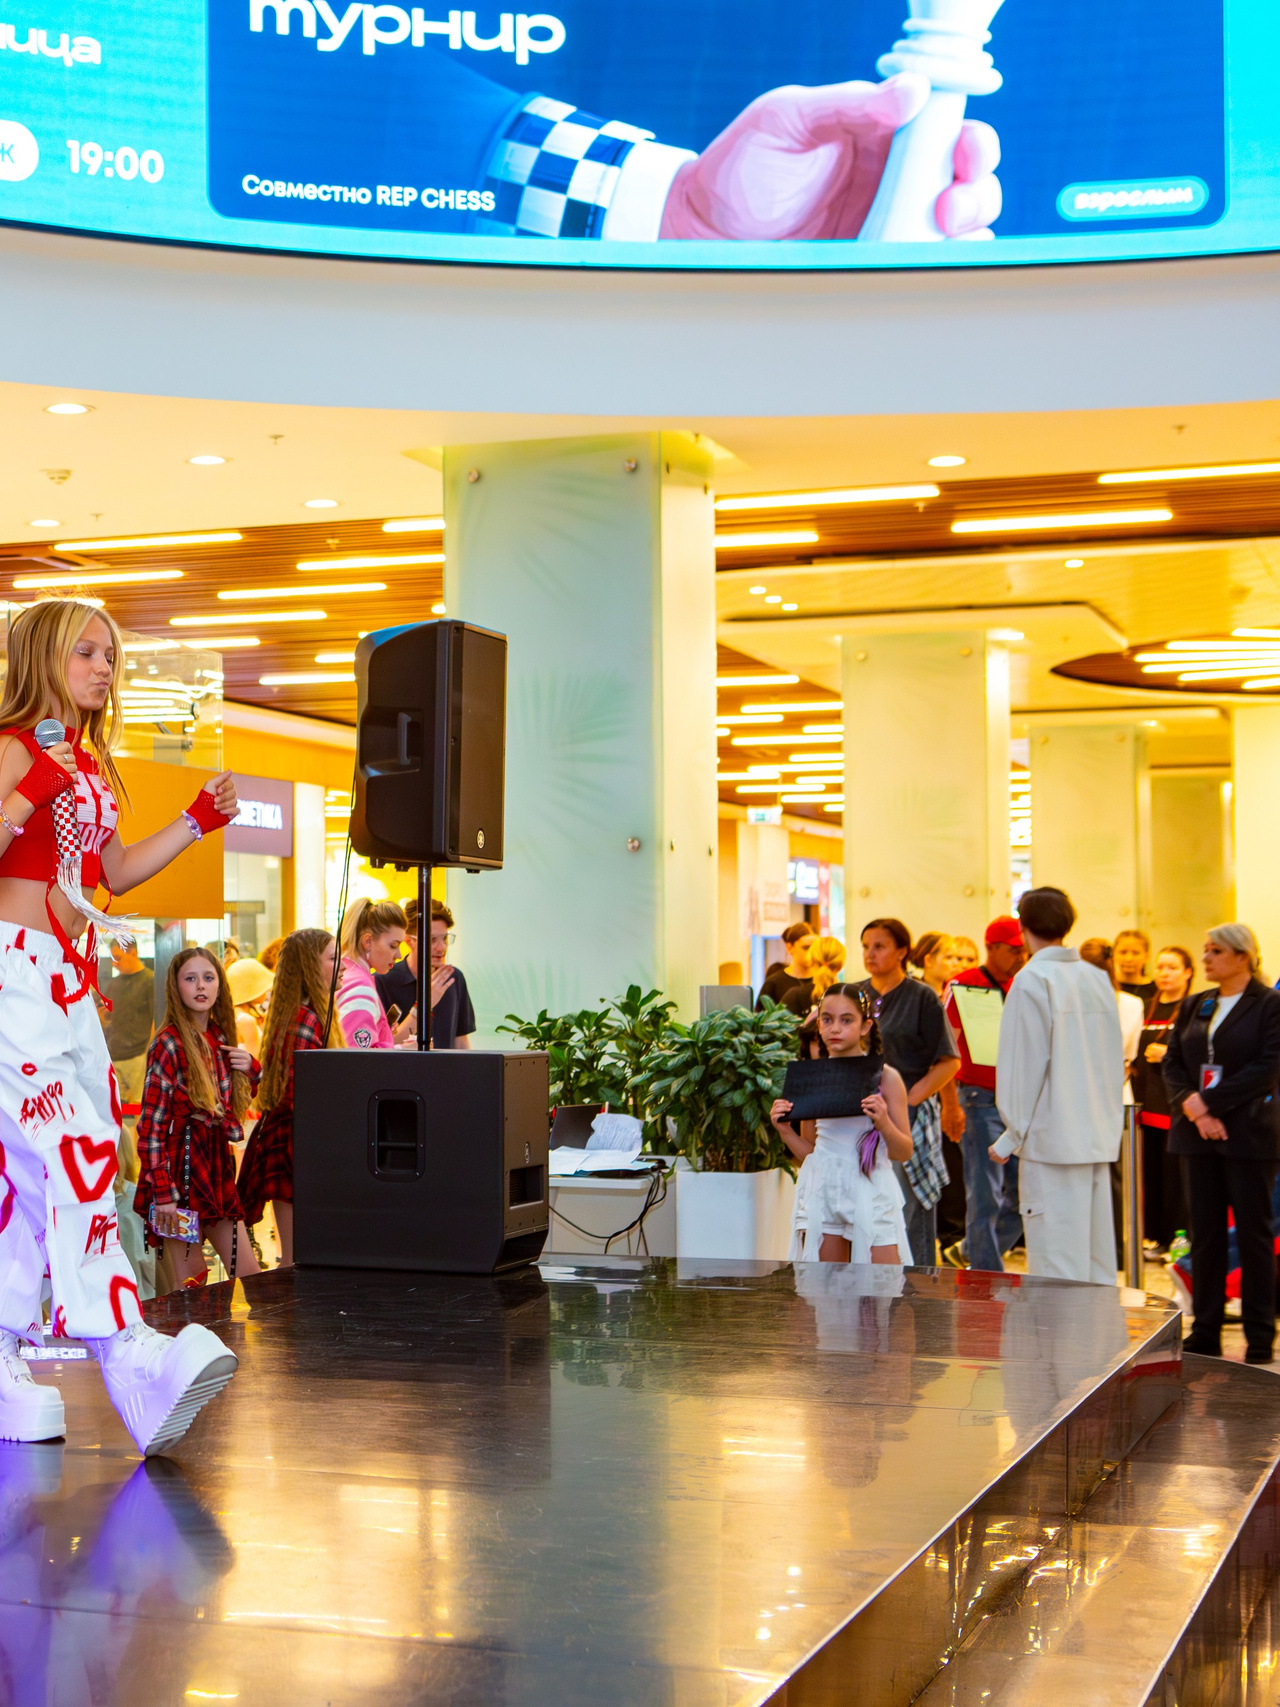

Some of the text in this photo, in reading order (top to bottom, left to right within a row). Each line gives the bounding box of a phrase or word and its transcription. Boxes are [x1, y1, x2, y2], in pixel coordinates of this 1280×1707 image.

[249, 0, 567, 65] турнир
[66, 139, 165, 184] 19:00
[241, 174, 496, 212] Совместно REP CHESS
